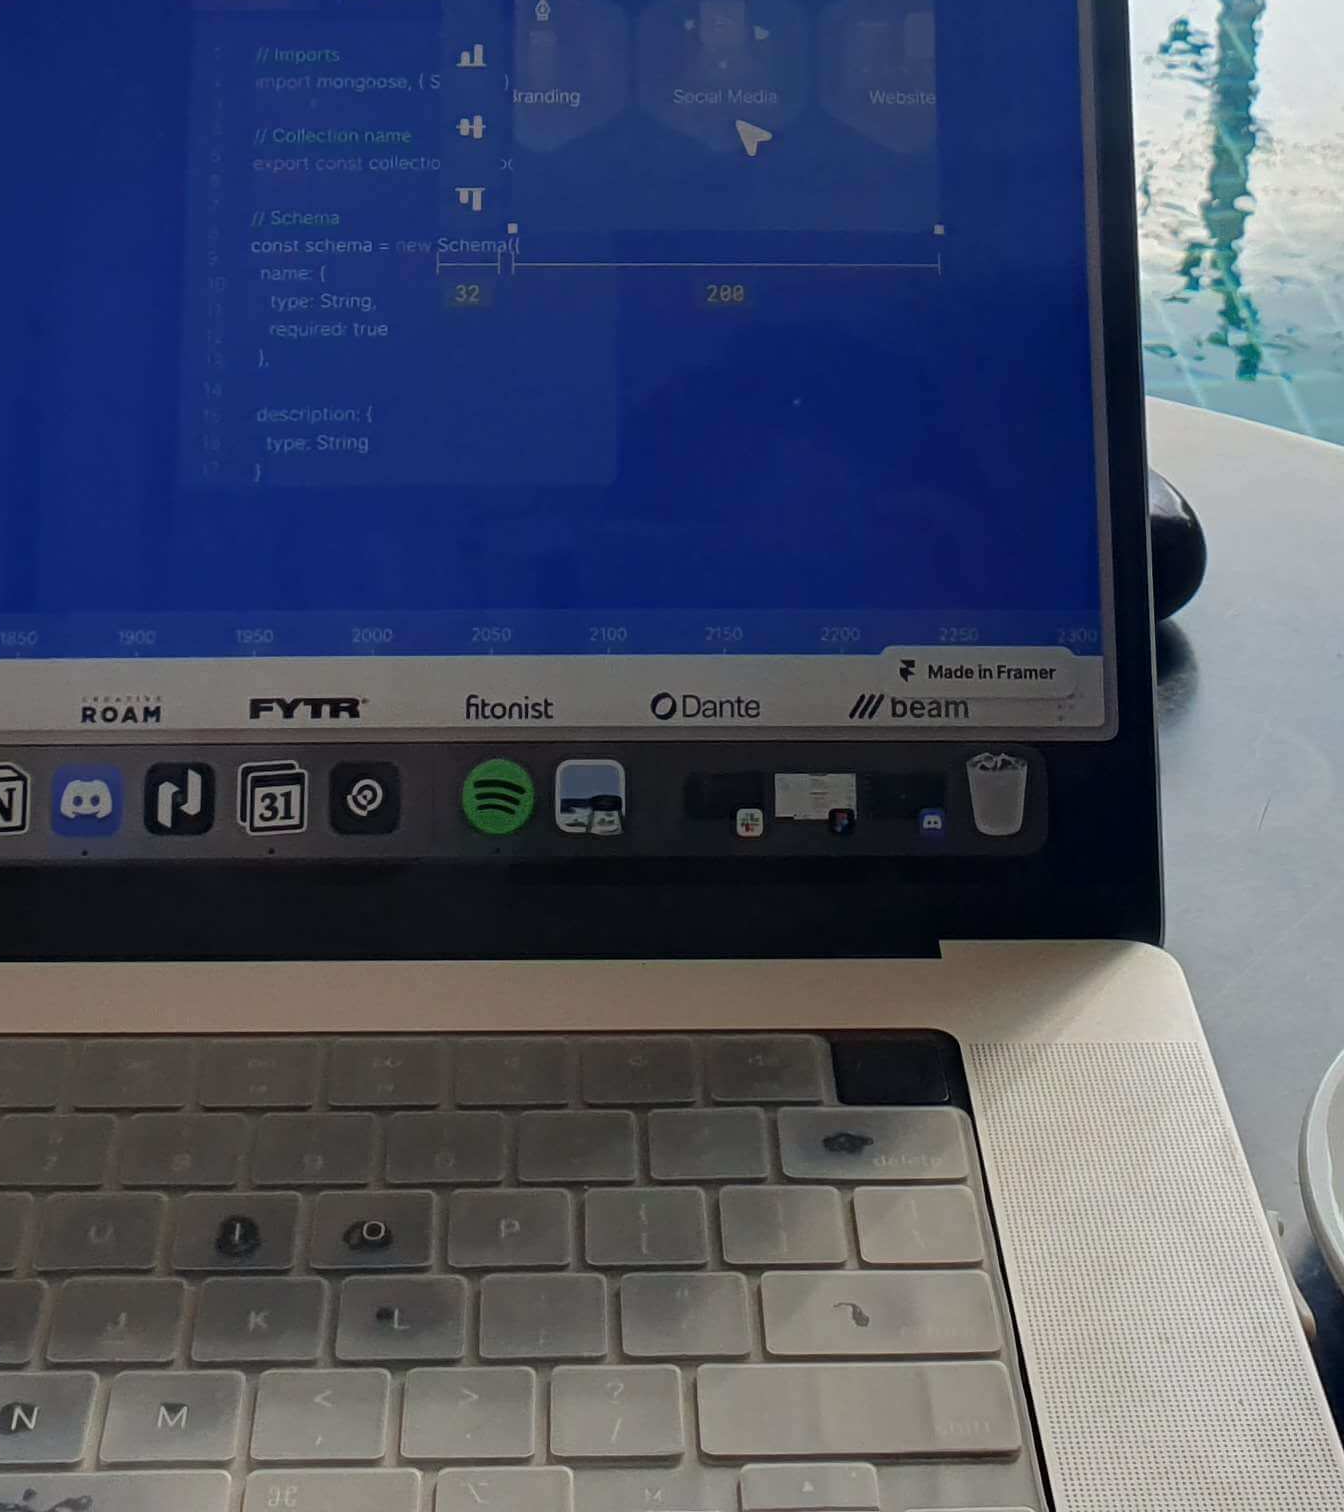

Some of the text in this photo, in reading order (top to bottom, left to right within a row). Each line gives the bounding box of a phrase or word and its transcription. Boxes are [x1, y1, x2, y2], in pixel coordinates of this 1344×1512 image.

[274, 48, 340, 64] Imports
[673, 89, 778, 104] Social Media
[272, 128, 412, 144] Collection name
[271, 210, 340, 225] Schema
[251, 240, 299, 254] const
[306, 240, 373, 254] schema
[396, 241, 432, 254] new
[454, 284, 480, 304] 32
[353, 322, 389, 337] true
[316, 435, 369, 454] String
[117, 630, 156, 646] 1900
[352, 628, 394, 644] 2000
[471, 628, 512, 643] 2050
[588, 627, 629, 642] 2100
[704, 626, 744, 641] 2150
[820, 626, 862, 642] 2200
[927, 664, 1057, 681] Made in Framer
[81, 705, 161, 724] ROAM
[249, 697, 361, 720] FYTR
[465, 694, 554, 720] fitonist
[682, 694, 761, 719] Dante
[890, 695, 969, 720] beam
[259, 790, 296, 823] 31
[88, 1222, 116, 1245] U
[362, 1220, 387, 1241] O
[497, 1217, 521, 1240] P
[246, 1310, 270, 1331] K
[393, 1308, 410, 1331] L
[11, 1406, 40, 1431] N
[156, 1405, 189, 1431] M
